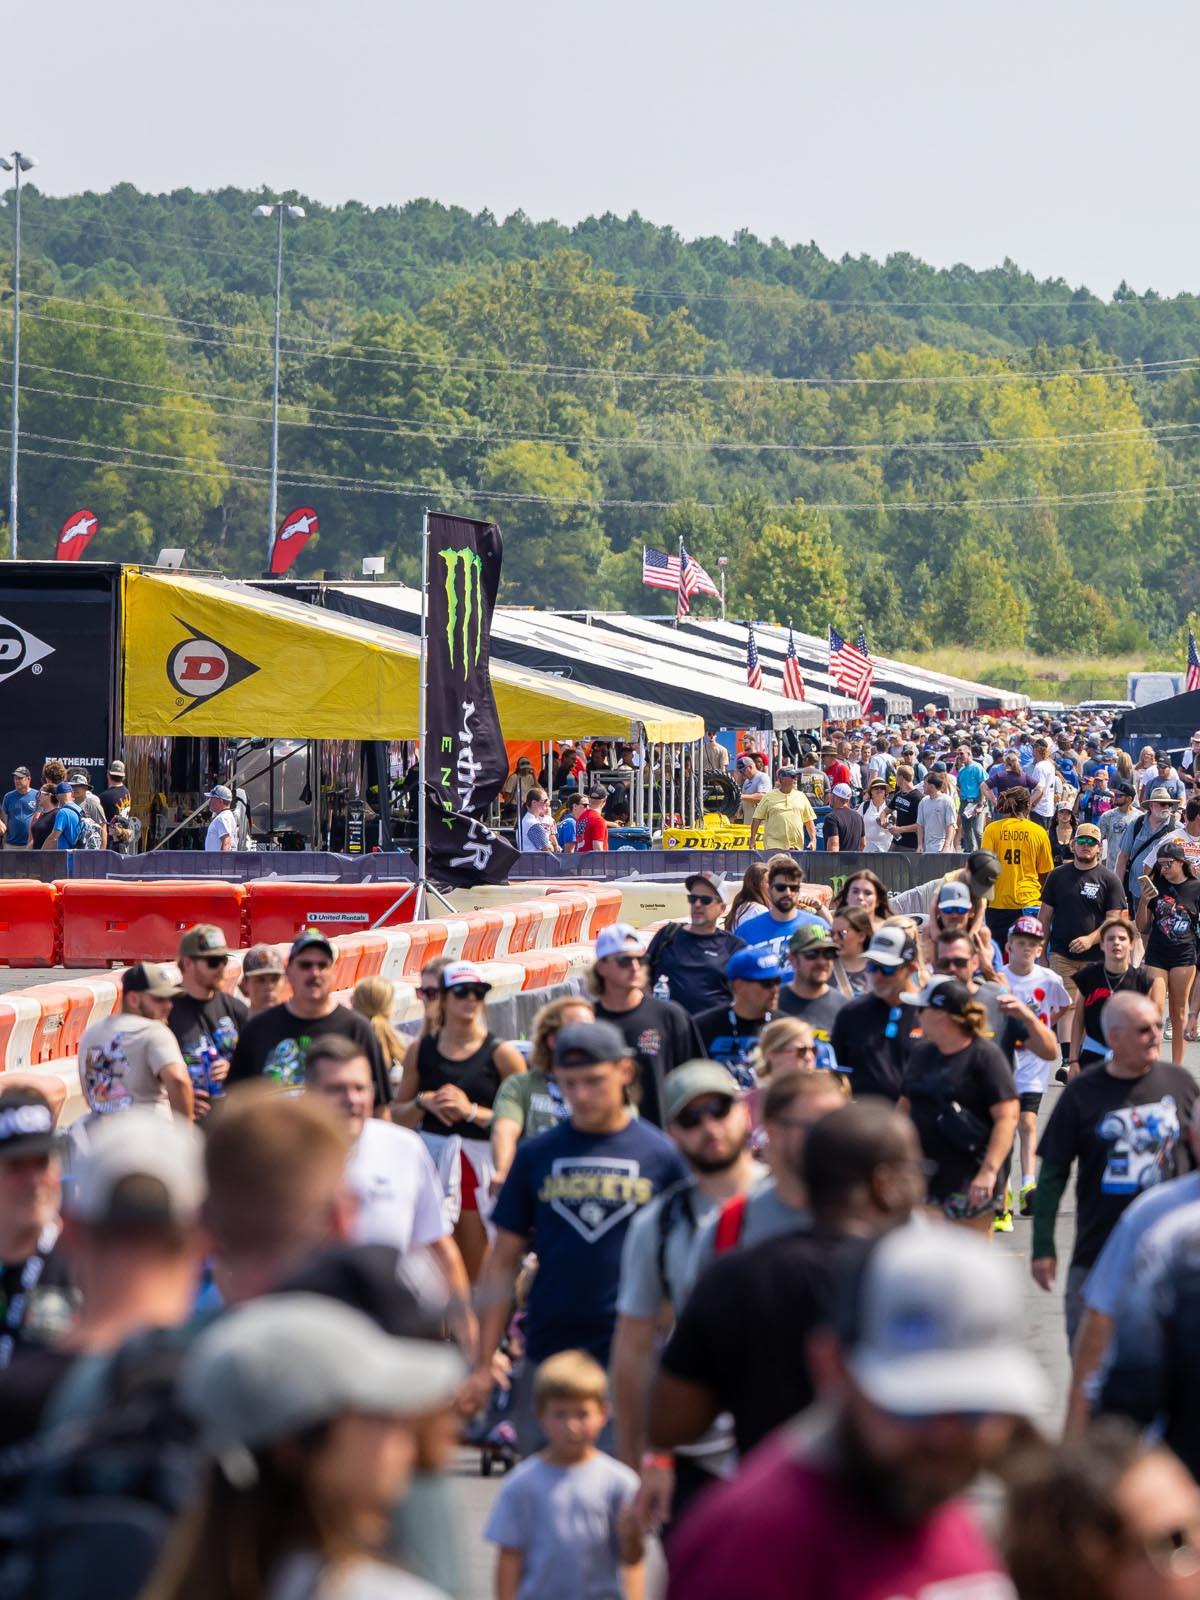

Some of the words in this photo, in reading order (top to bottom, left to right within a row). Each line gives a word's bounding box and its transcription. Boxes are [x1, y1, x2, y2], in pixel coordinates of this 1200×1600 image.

[180, 655, 226, 681] D
[1000, 830, 1029, 841] VENDOR
[1004, 849, 1021, 865] 48
